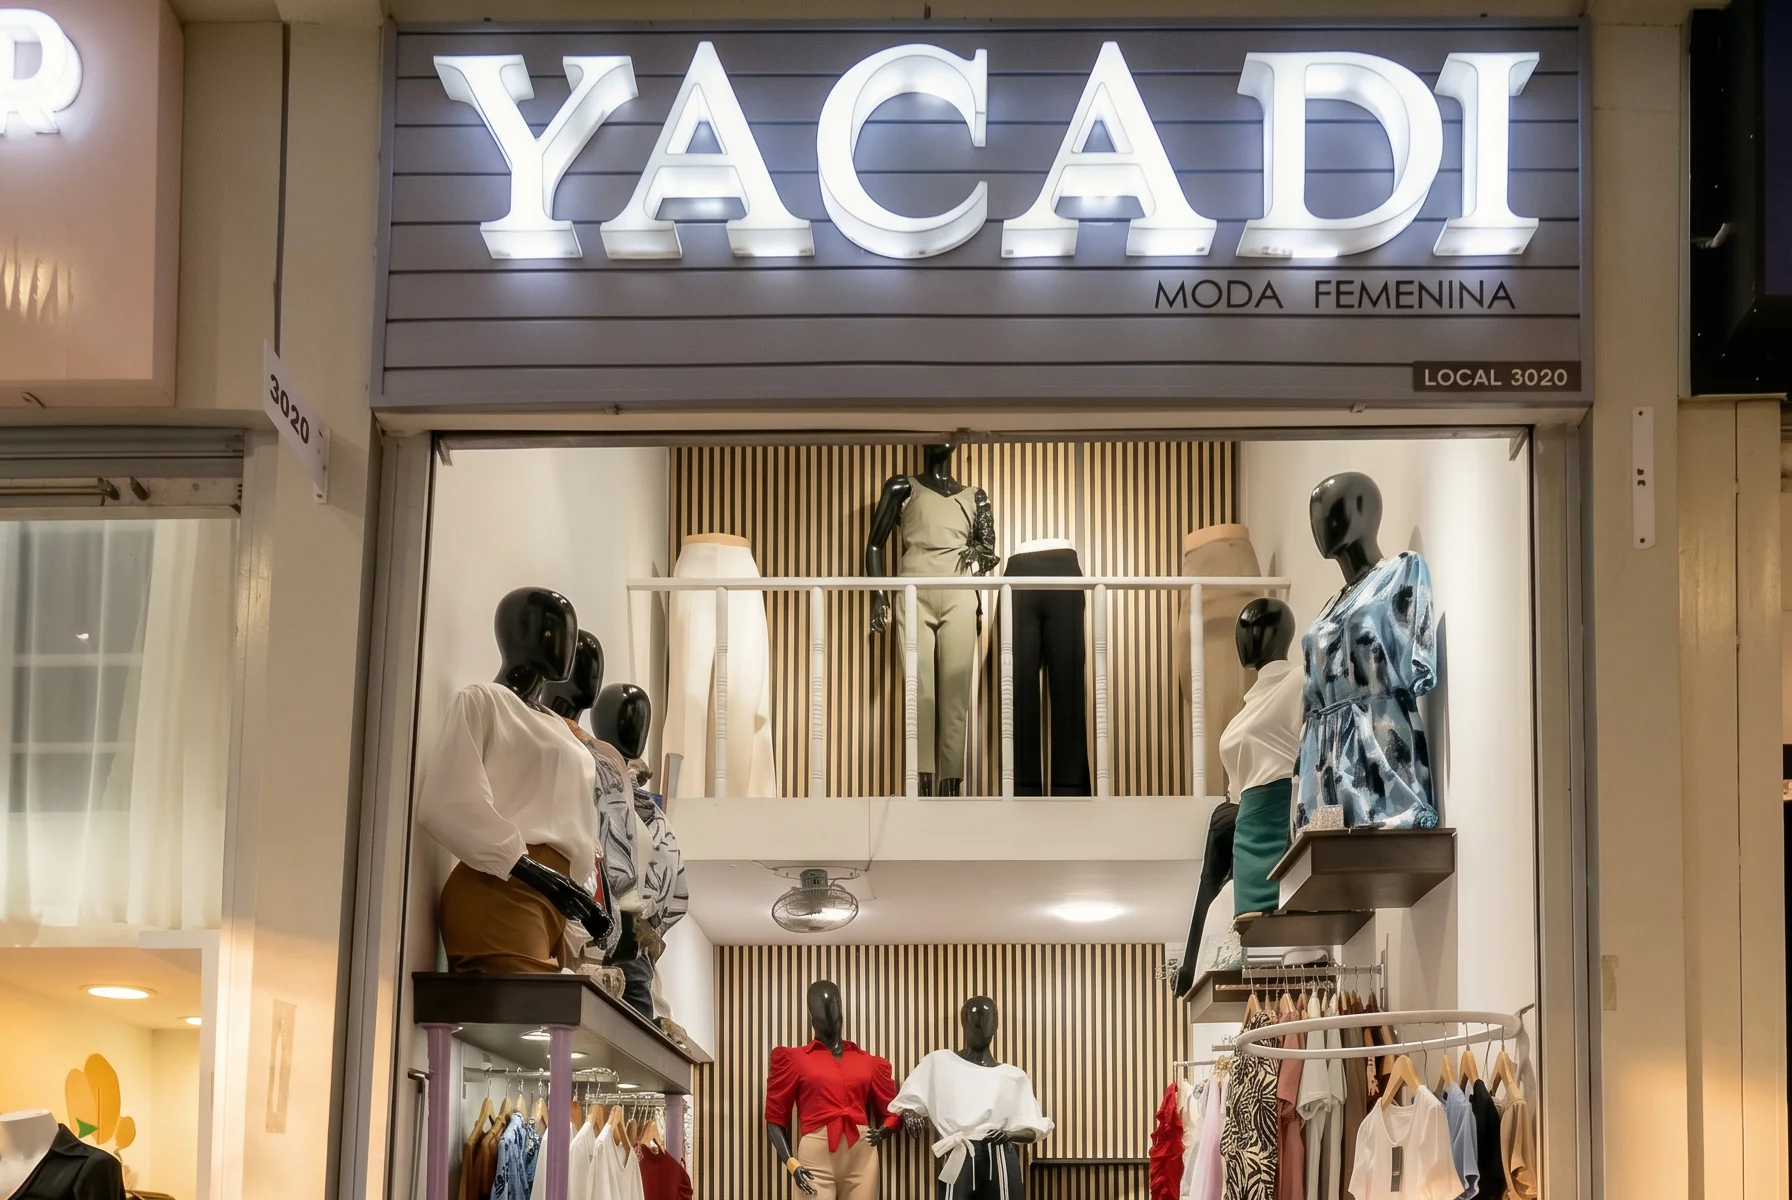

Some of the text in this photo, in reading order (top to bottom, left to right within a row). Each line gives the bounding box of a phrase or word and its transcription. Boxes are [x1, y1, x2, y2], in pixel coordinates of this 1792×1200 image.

[433, 40, 1540, 260] YACADI
[1154, 279, 1516, 310] MODA FEMENINA
[1424, 367, 1569, 387] LOCAL 3020
[269, 373, 310, 445] 3020
